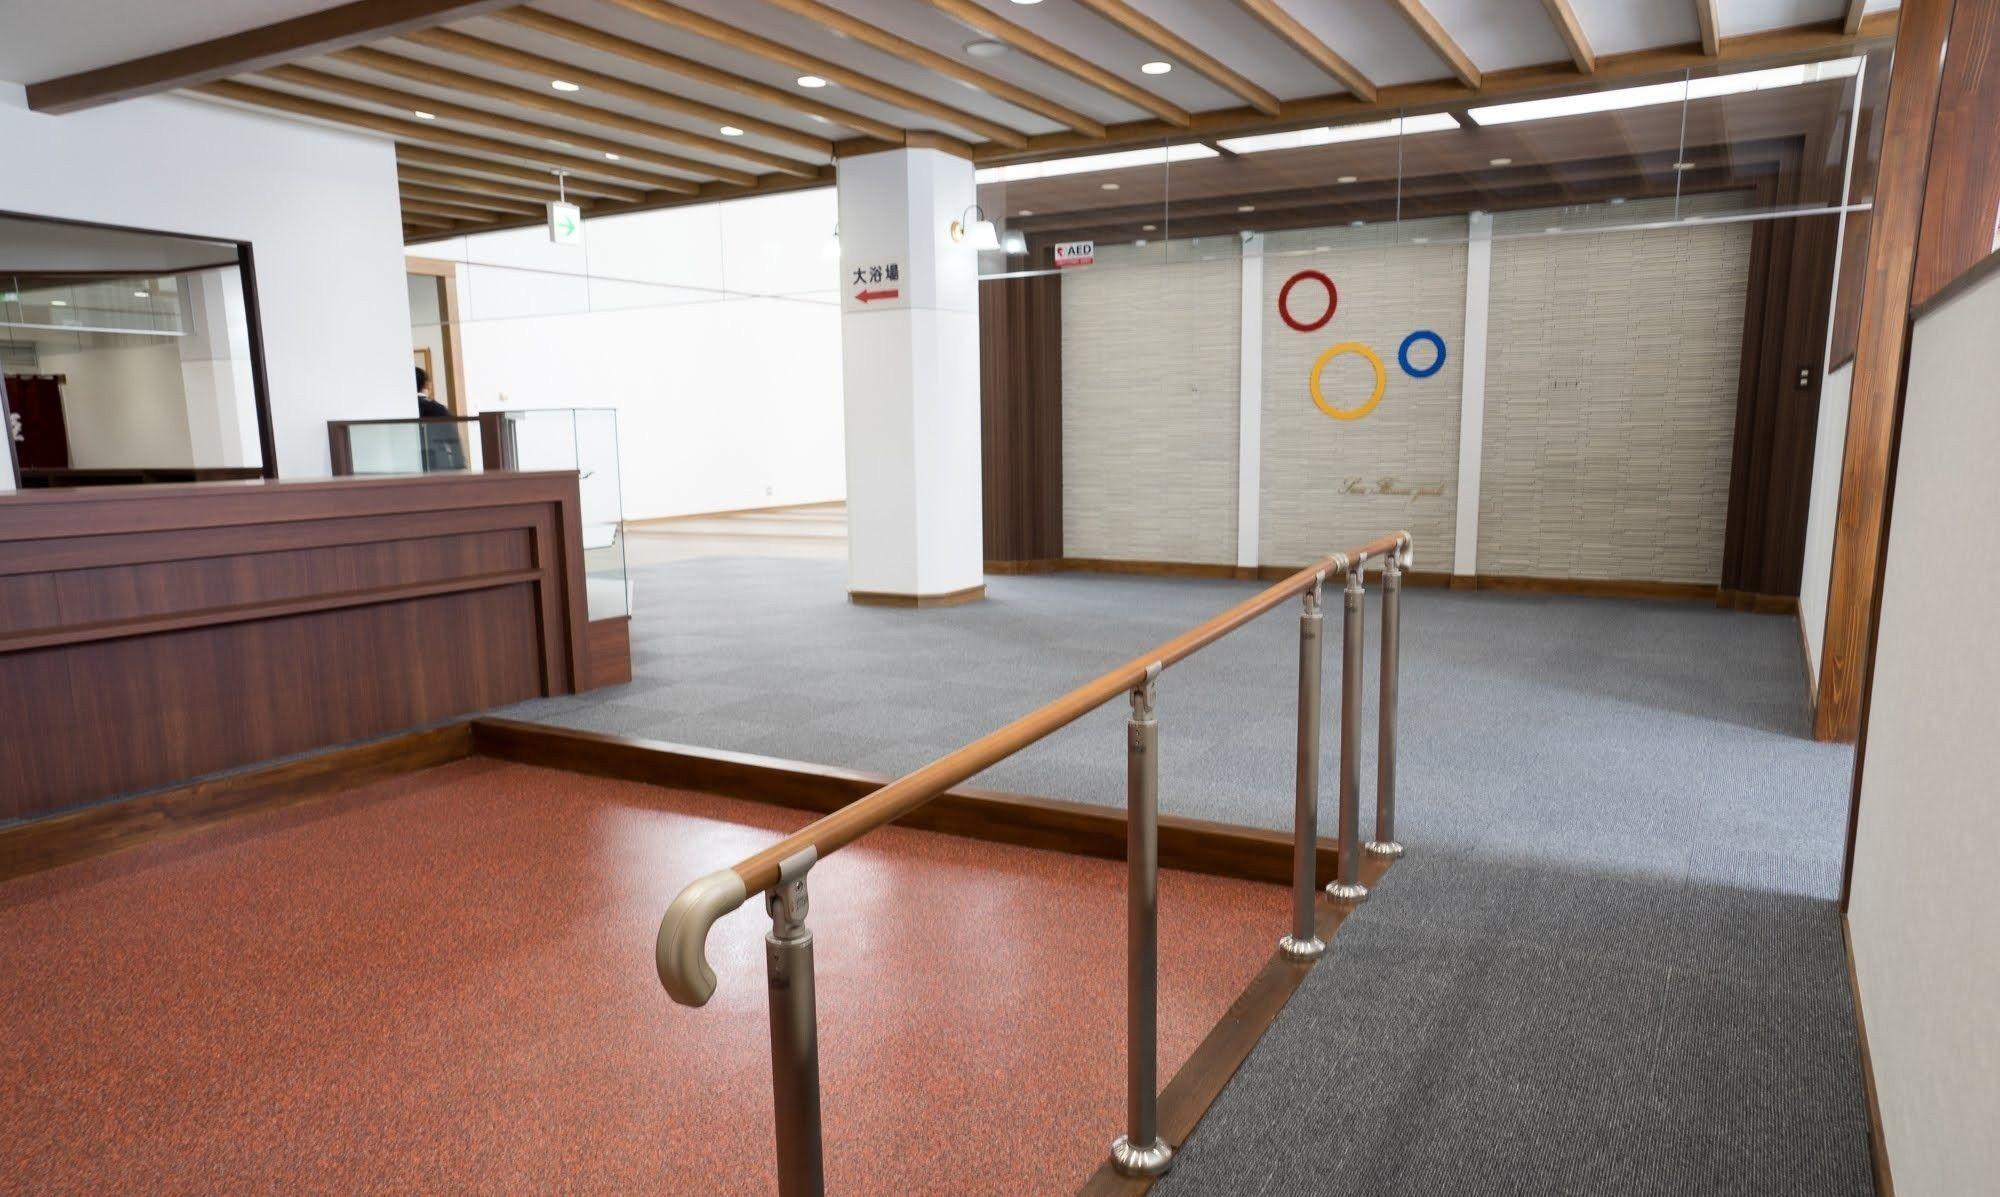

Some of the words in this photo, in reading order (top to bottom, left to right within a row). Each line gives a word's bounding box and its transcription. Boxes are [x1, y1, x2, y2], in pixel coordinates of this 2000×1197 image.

[1067, 244, 1092, 256] AED
[853, 263, 899, 285] 大浴場
